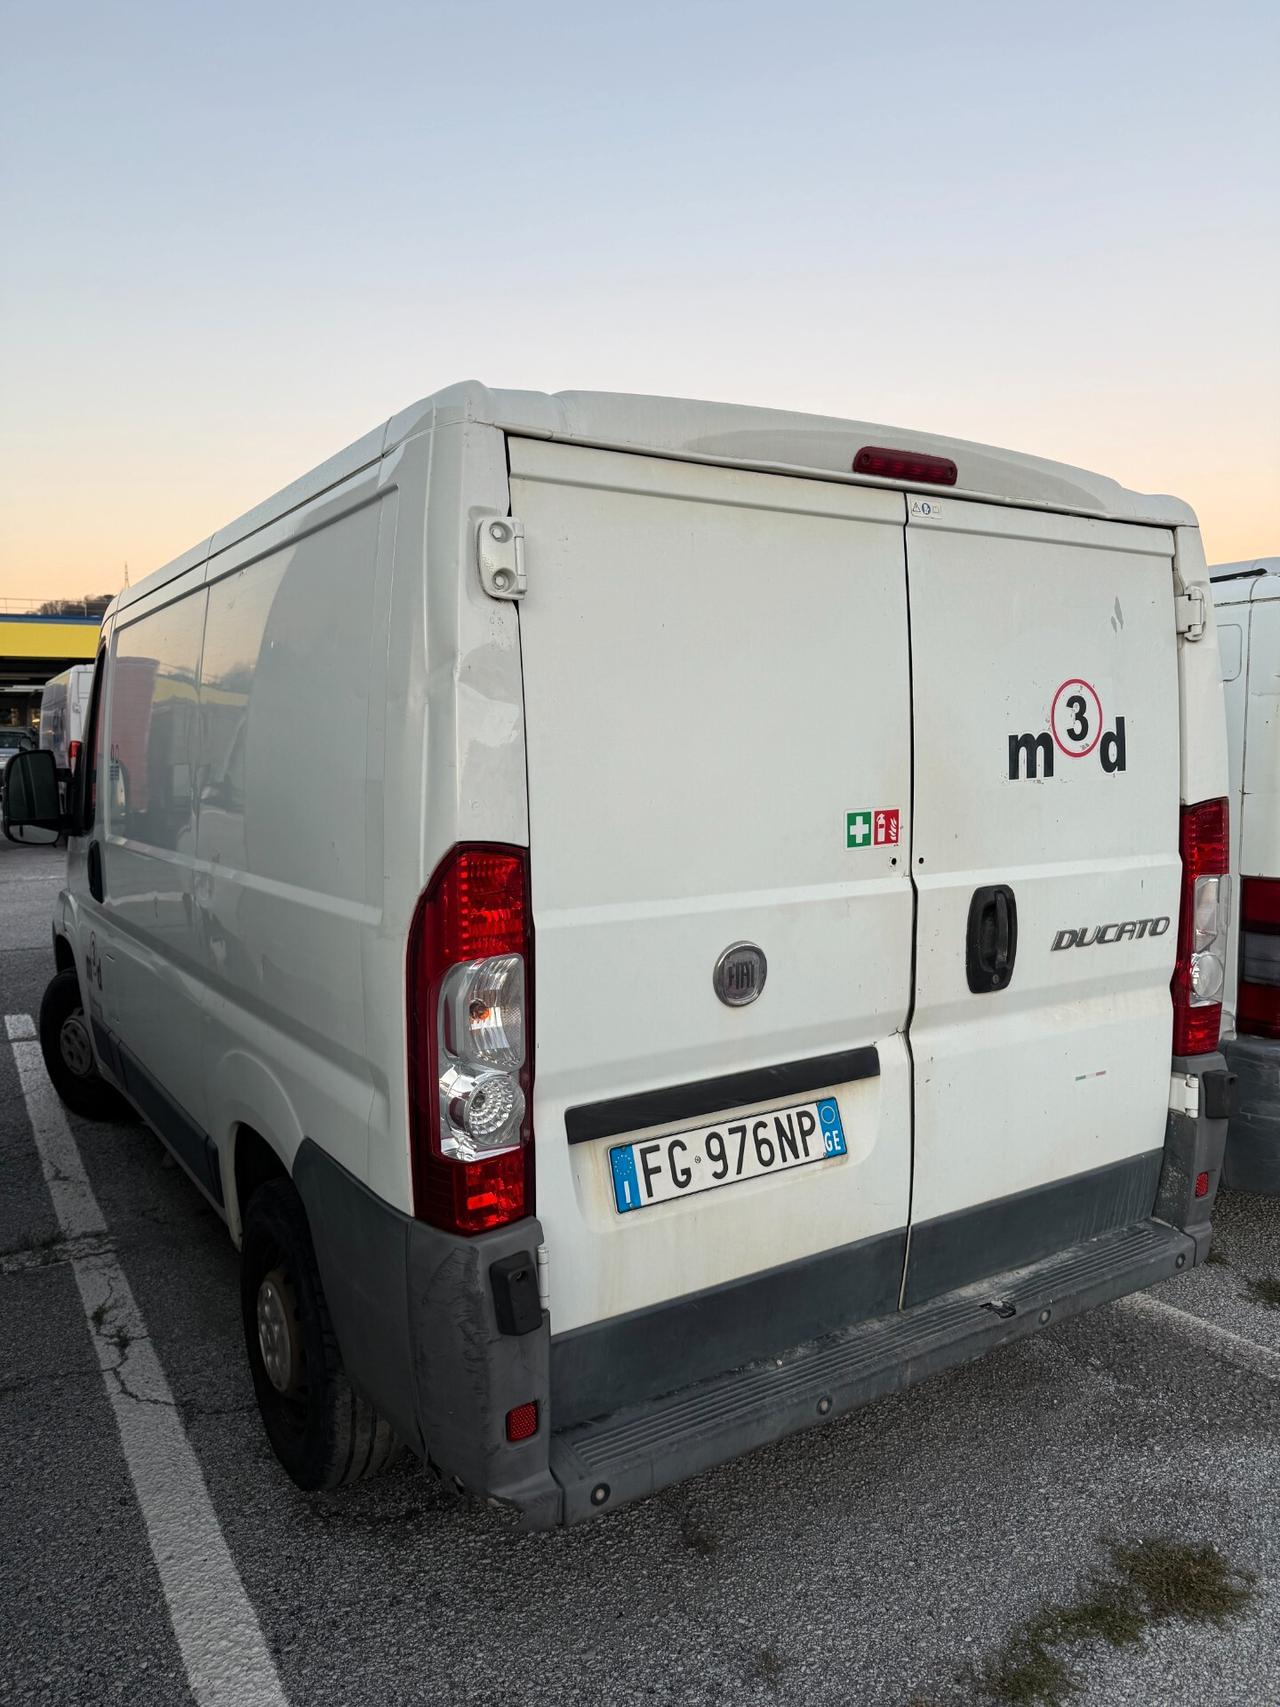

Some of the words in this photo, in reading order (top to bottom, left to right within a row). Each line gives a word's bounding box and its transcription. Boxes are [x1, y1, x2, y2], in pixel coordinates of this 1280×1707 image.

[1051, 916, 1170, 951] DUCATO
[824, 1129, 842, 1152] GE
[623, 1180, 631, 1204] I
